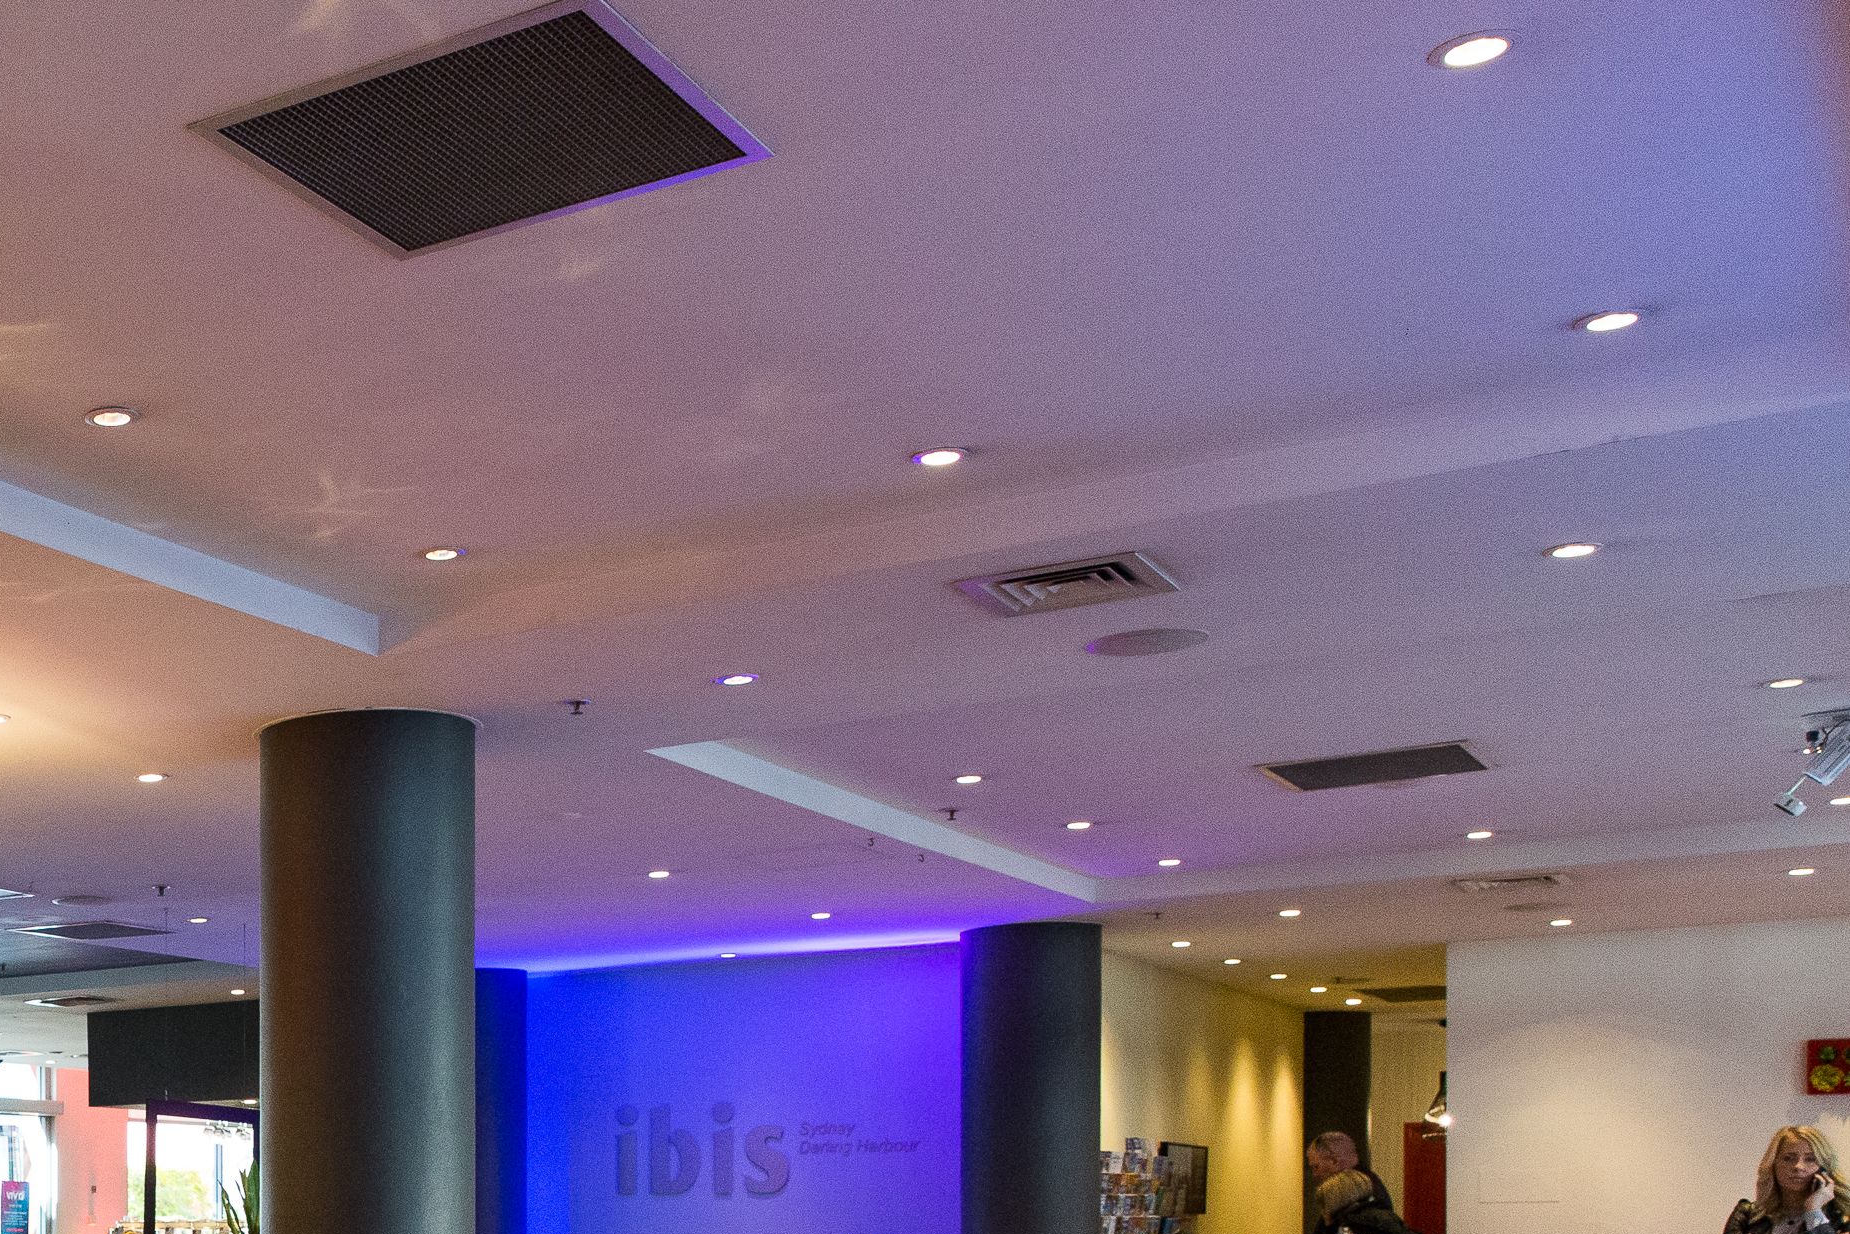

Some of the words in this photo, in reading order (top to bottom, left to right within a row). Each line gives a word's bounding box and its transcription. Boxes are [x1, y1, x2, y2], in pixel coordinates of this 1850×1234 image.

[616, 1103, 791, 1197] ibis
[800, 1139, 851, 1157] Darling
[856, 1138, 921, 1154] Harbour
